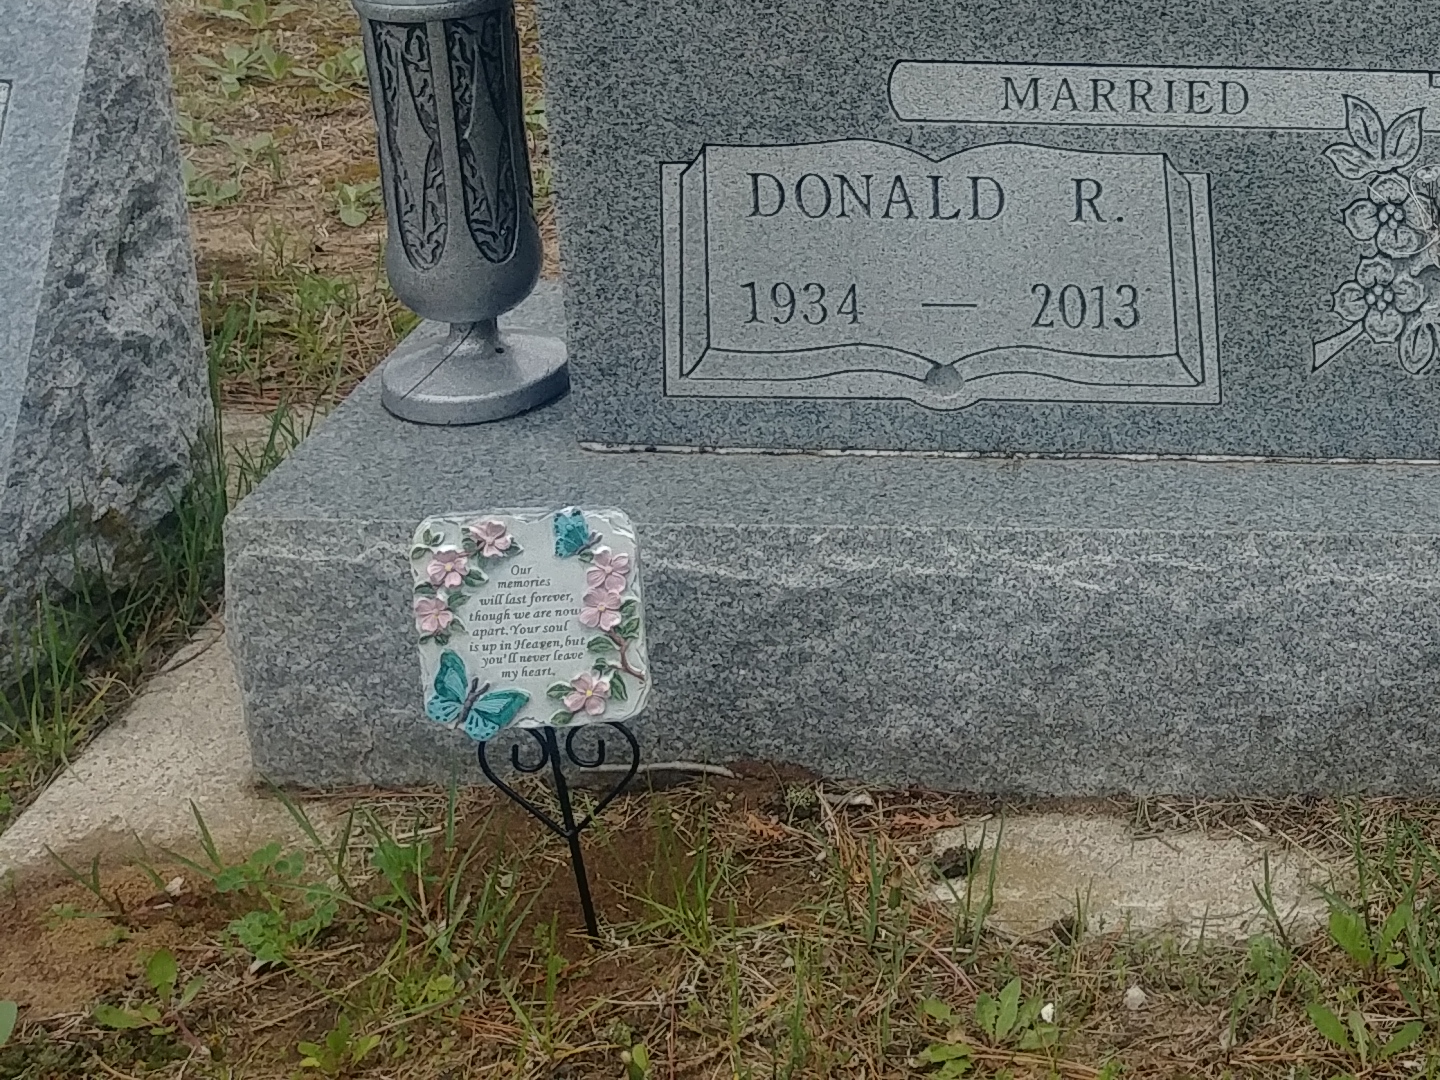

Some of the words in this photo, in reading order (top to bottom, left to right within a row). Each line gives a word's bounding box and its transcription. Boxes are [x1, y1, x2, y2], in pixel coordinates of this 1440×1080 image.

[1000, 76, 1249, 115] MARRIED
[745, 172, 1005, 221] DONALD
[1070, 177, 1124, 224] R.
[741, 281, 863, 325] 1934
[1030, 283, 1141, 329] 2013
[511, 565, 532, 575] Our
[498, 576, 551, 588] memories
[480, 594, 504, 606] will
[505, 593, 527, 605] last
[527, 592, 574, 607] forever,
[469, 609, 511, 624] though
[513, 610, 530, 620] we
[533, 609, 552, 618] are
[555, 608, 581, 617] now
[472, 626, 509, 639] apart.
[510, 624, 541, 635] Your
[542, 620, 570, 633] soul
[470, 642, 479, 652] is
[482, 643, 497, 654] up
[500, 640, 511, 651] in
[514, 639, 564, 650] Heaven,
[565, 635, 585, 646] but
[481, 652, 518, 668] you'll
[520, 653, 551, 663] never
[553, 650, 584, 661] leave
[502, 669, 518, 681] my
[521, 666, 556, 677] heart.
